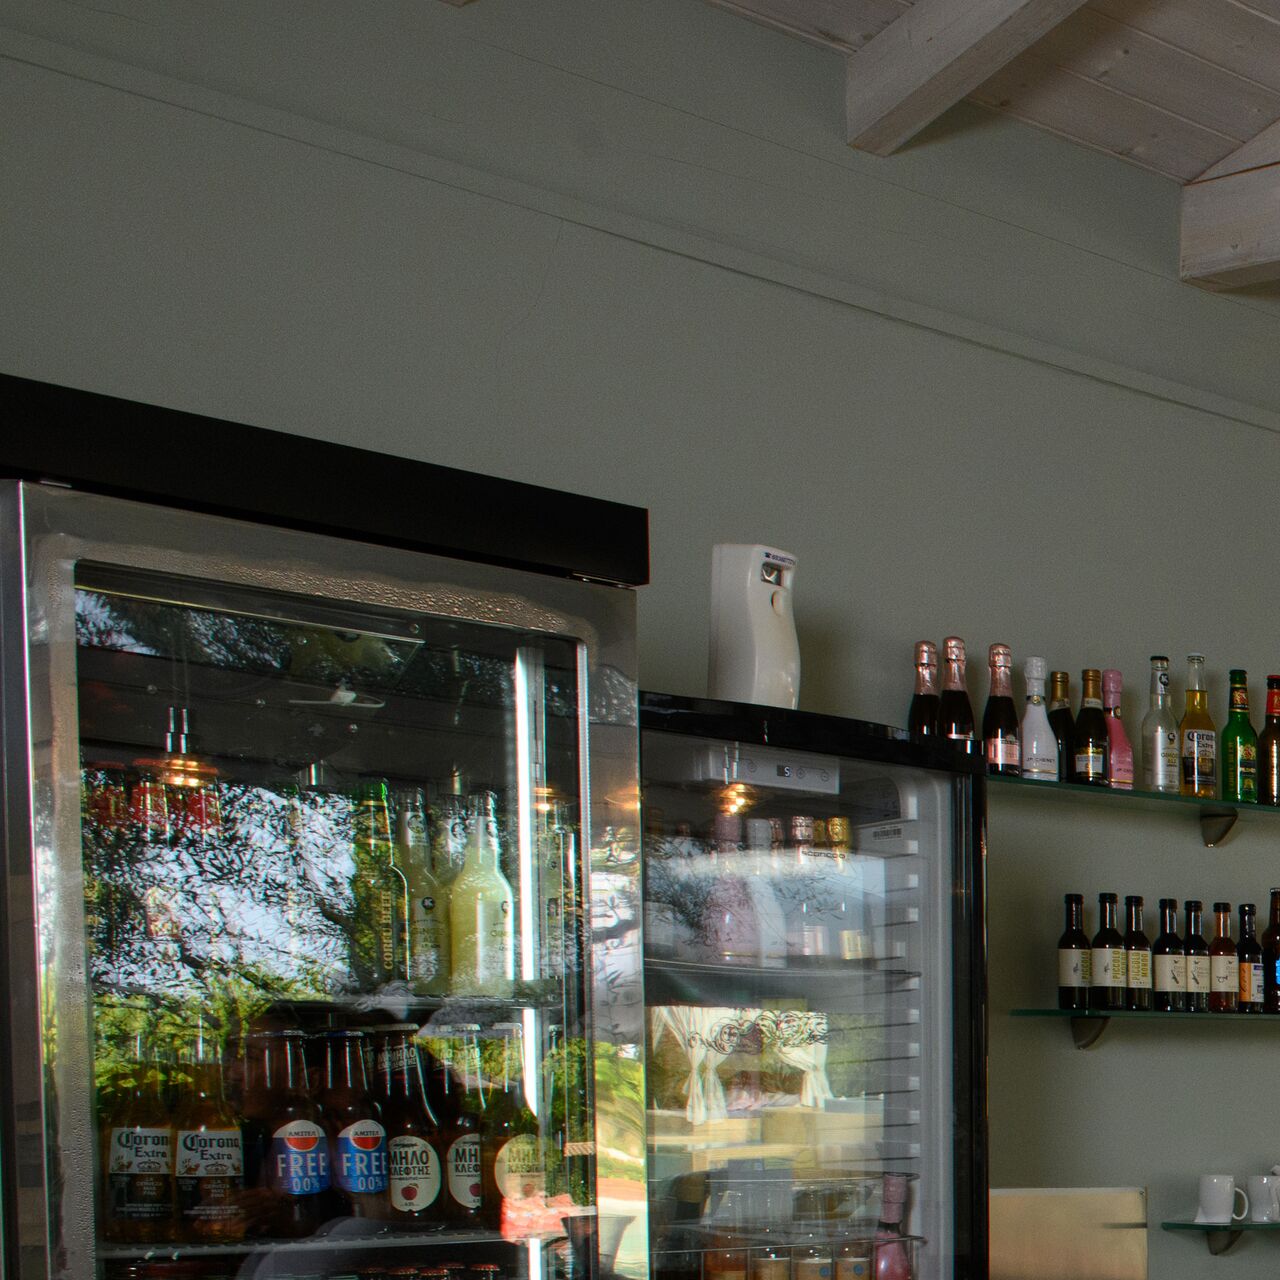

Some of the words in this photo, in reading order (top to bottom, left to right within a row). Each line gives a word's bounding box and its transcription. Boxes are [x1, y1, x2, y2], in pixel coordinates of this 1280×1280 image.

[135, 1146, 167, 1158] Extra
[200, 1149, 233, 1161] Extra
[277, 1153, 326, 1177] FREE
[341, 1152, 387, 1177] FREE
